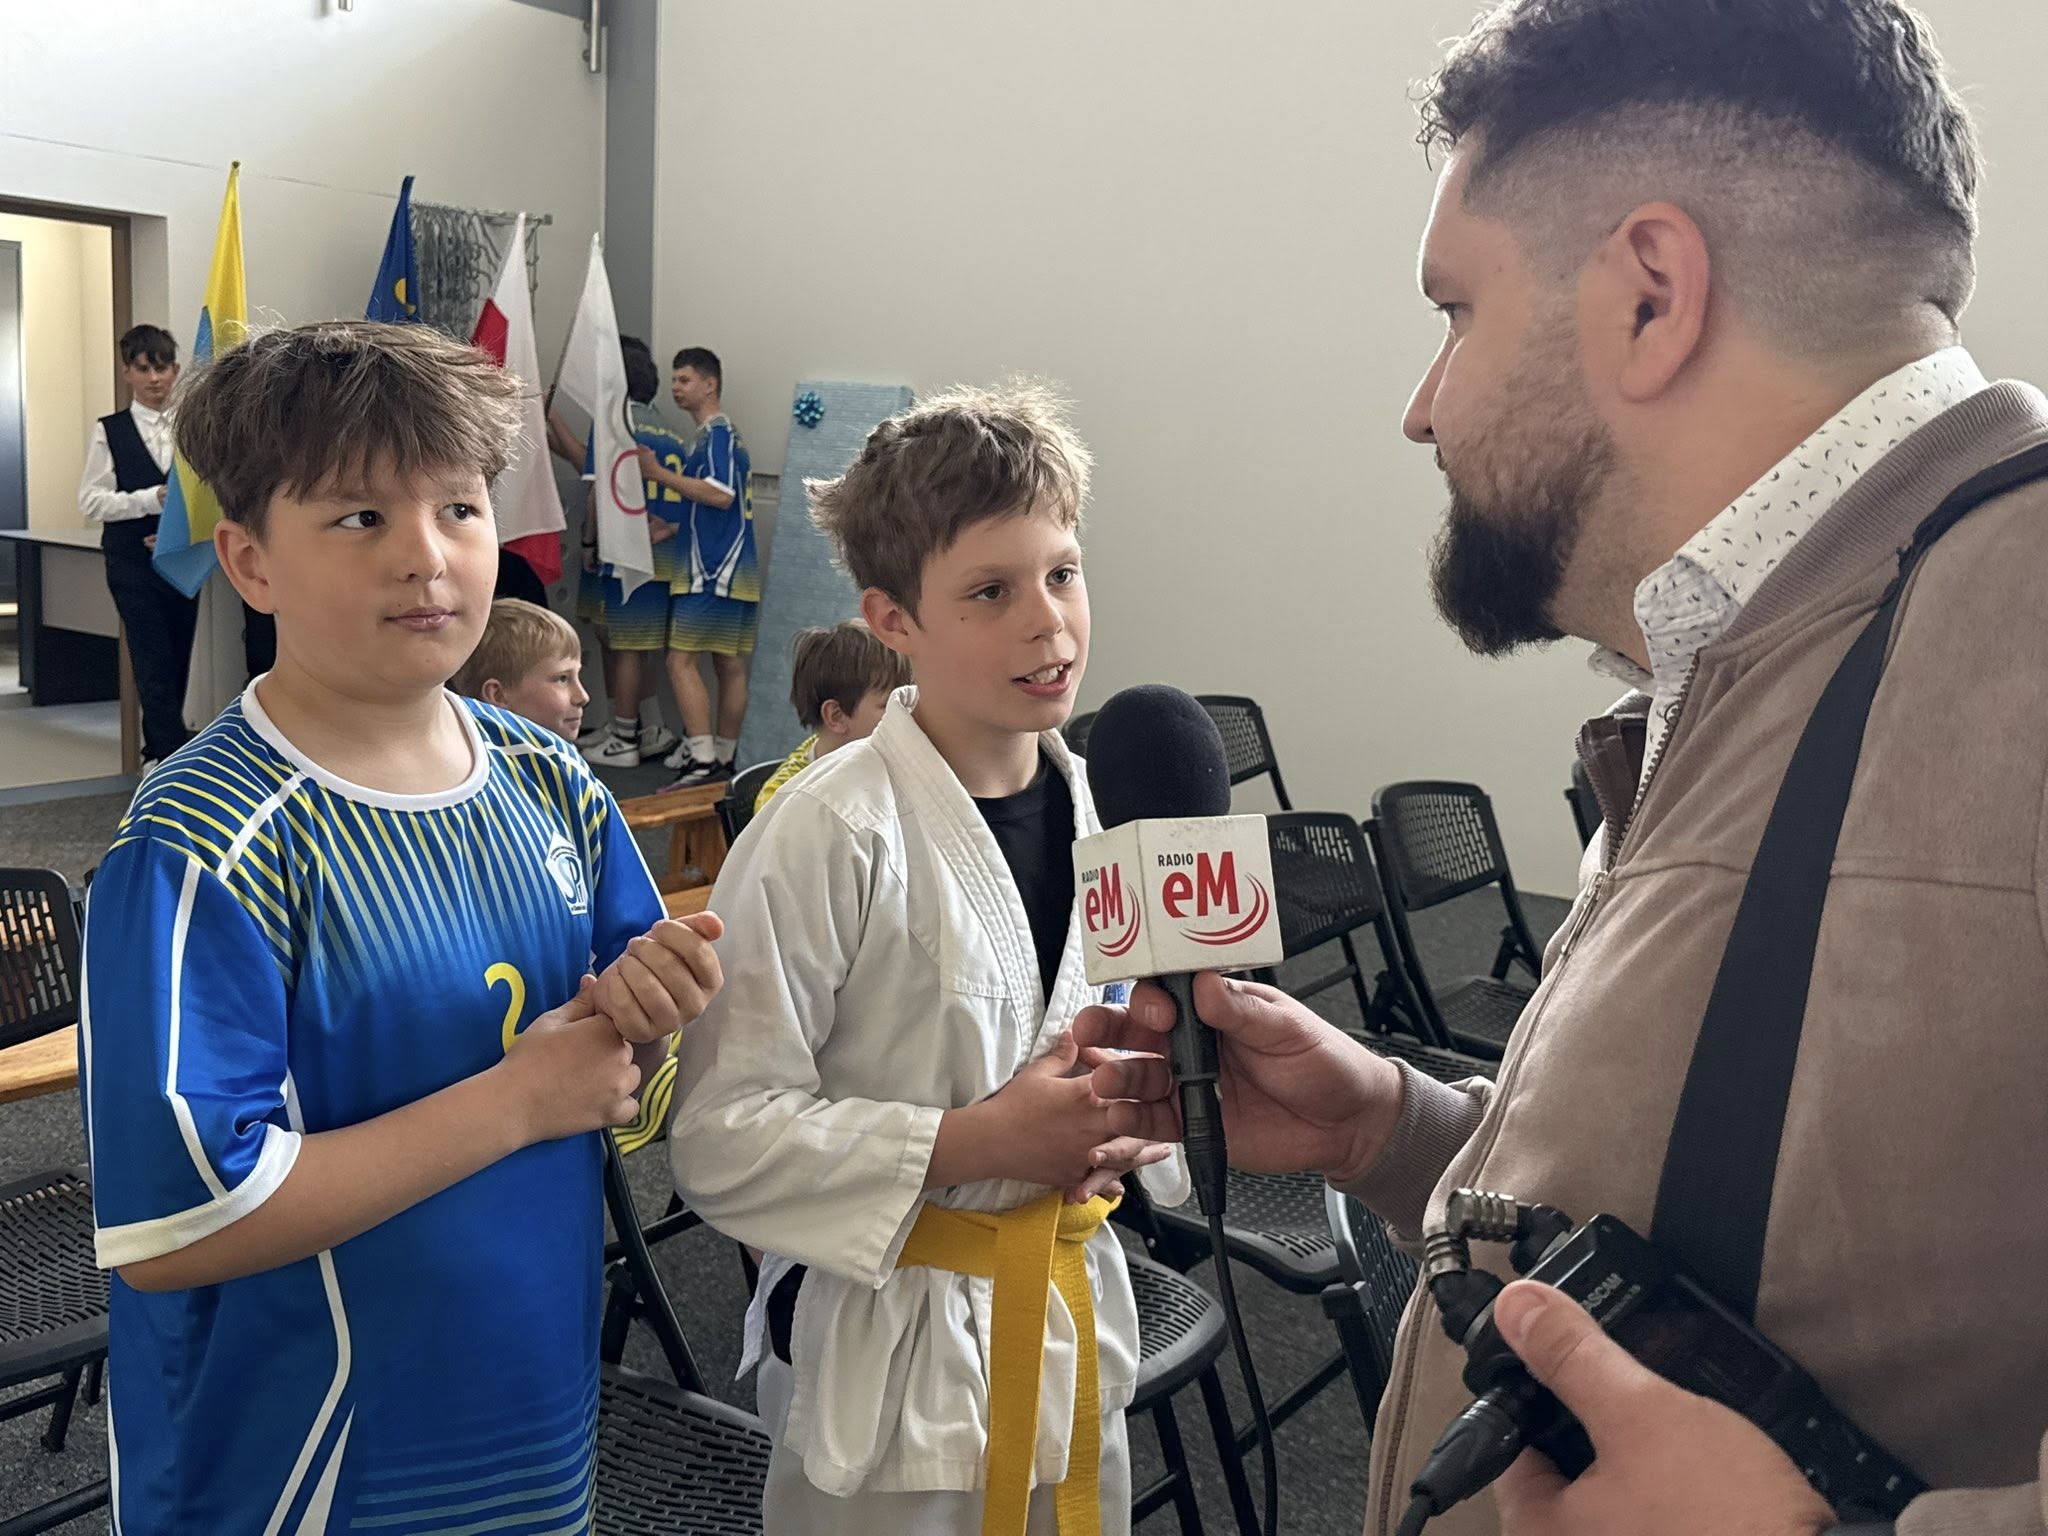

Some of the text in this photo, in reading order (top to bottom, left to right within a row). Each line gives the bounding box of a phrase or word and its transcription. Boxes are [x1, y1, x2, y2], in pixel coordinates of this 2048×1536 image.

[1081, 868, 1099, 884] RADIO
[1157, 853, 1194, 867] RADIO
[1162, 851, 1240, 919] eM
[1085, 862, 1125, 932] eM
[484, 962, 526, 1054] 2
[1581, 1272, 1623, 1313] ASCAM
